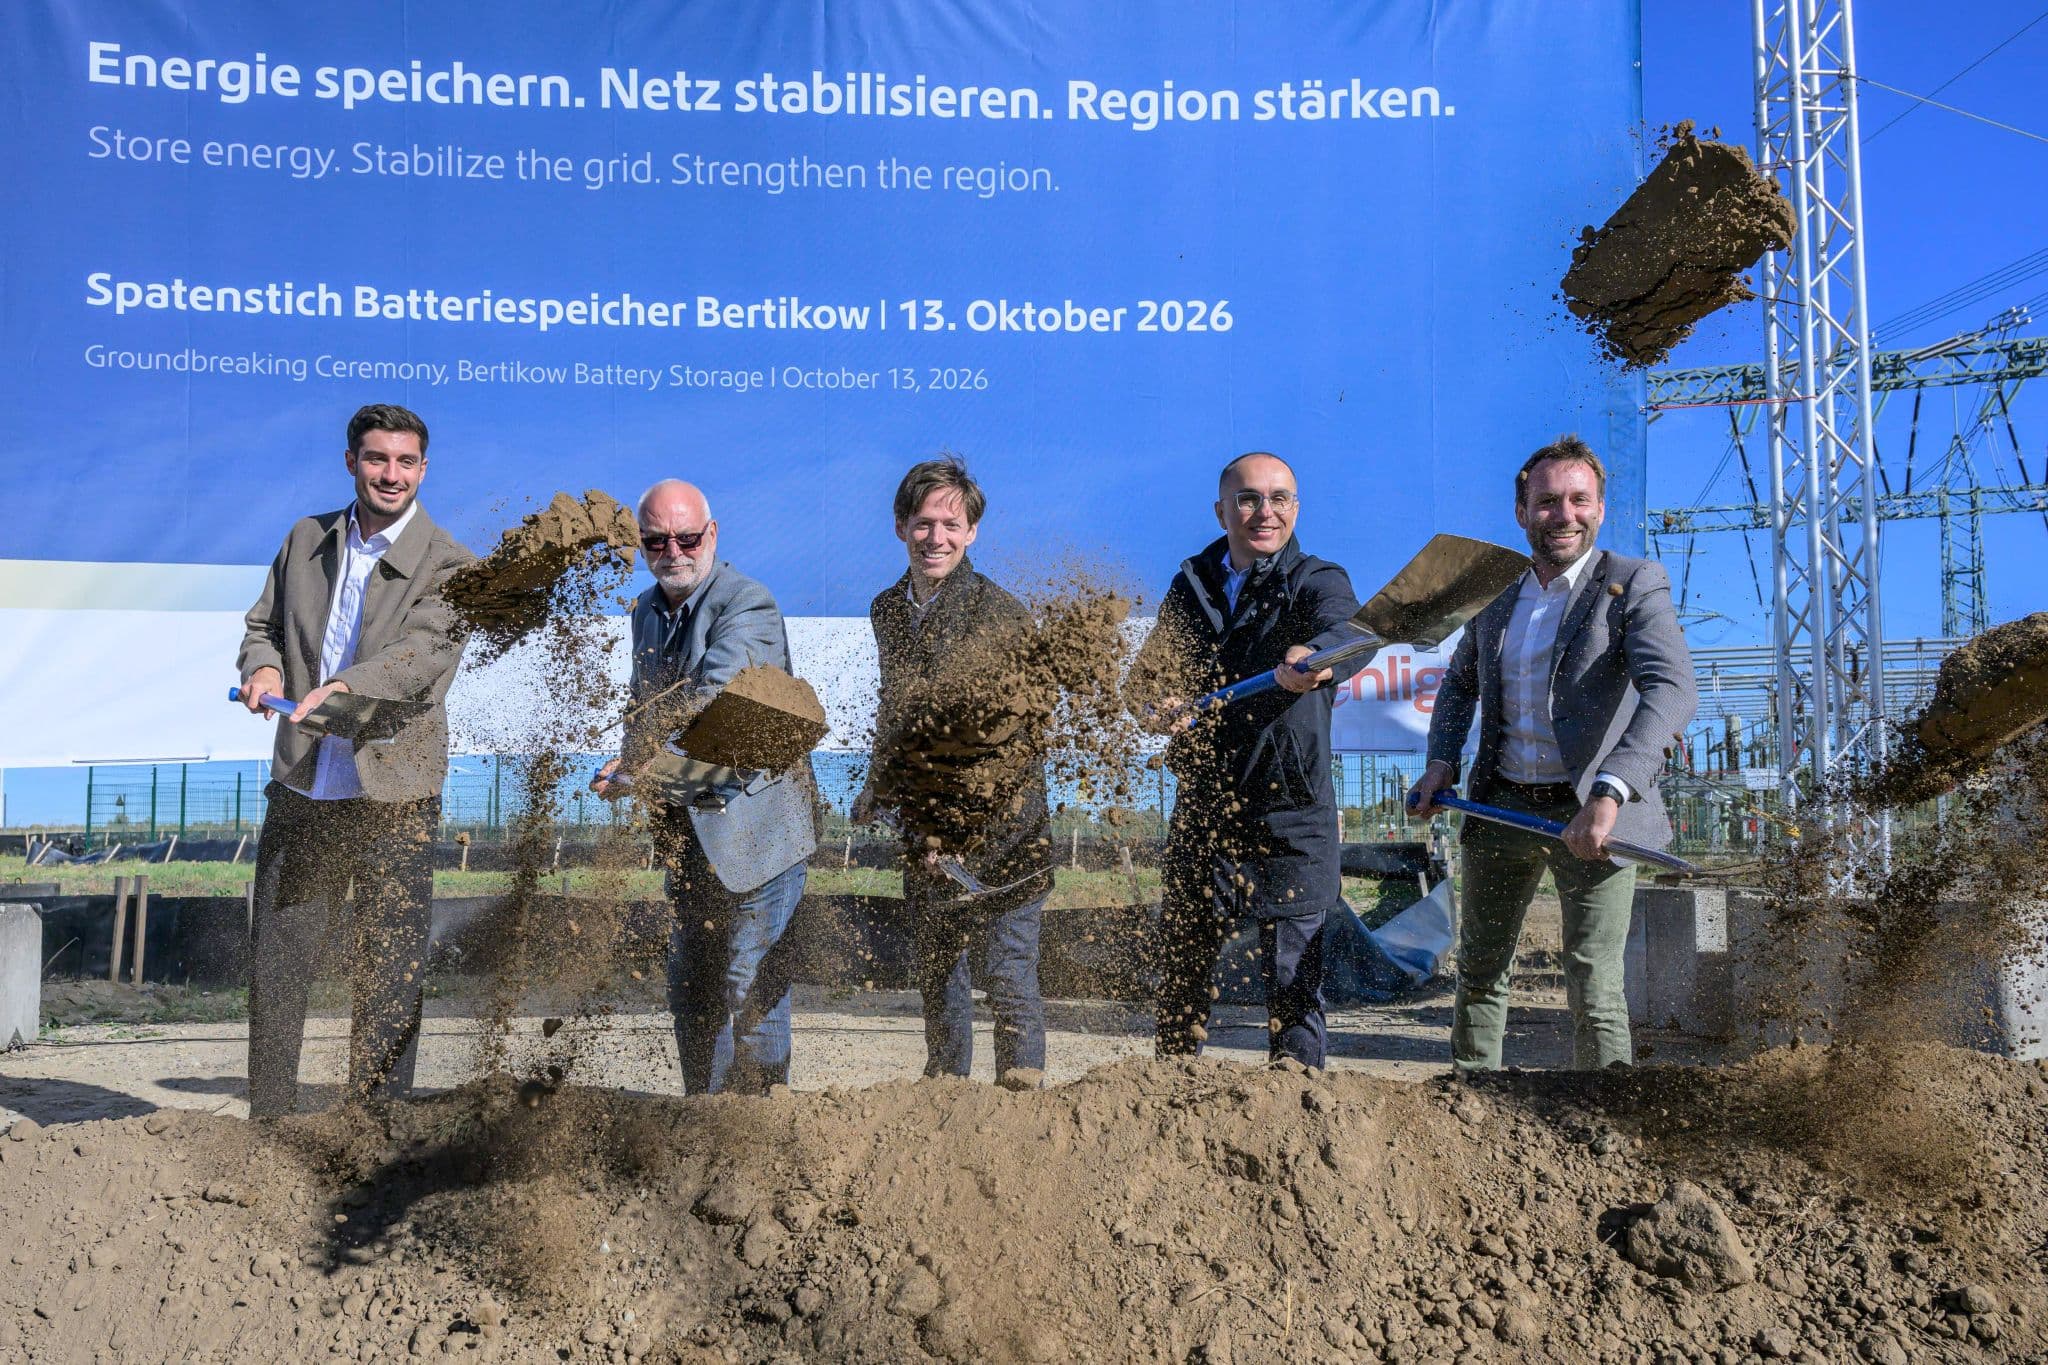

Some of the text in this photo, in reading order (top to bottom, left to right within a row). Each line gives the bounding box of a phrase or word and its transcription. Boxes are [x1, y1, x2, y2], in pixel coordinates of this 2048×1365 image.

[87, 40, 1456, 132] Energie speichern. Netz stabilisieren. Region stärken.
[88, 125, 1060, 199] Store energy. Stabilize the grid. Strengthen the region.
[85, 271, 343, 318] Spatenstich
[354, 285, 688, 332] Batteriespeicher
[696, 295, 871, 332] Bertikow
[898, 298, 957, 332] 13.
[965, 298, 1128, 333] Oktober
[1136, 299, 1234, 333] 2026
[84, 344, 308, 382] Groundbreaking
[314, 354, 450, 386] Ceremony,
[458, 359, 568, 384] Bertikow
[574, 362, 663, 391] Battery
[669, 364, 764, 393] Storage
[782, 366, 881, 390] October
[887, 367, 921, 394] 13,
[928, 367, 989, 391] 2026
